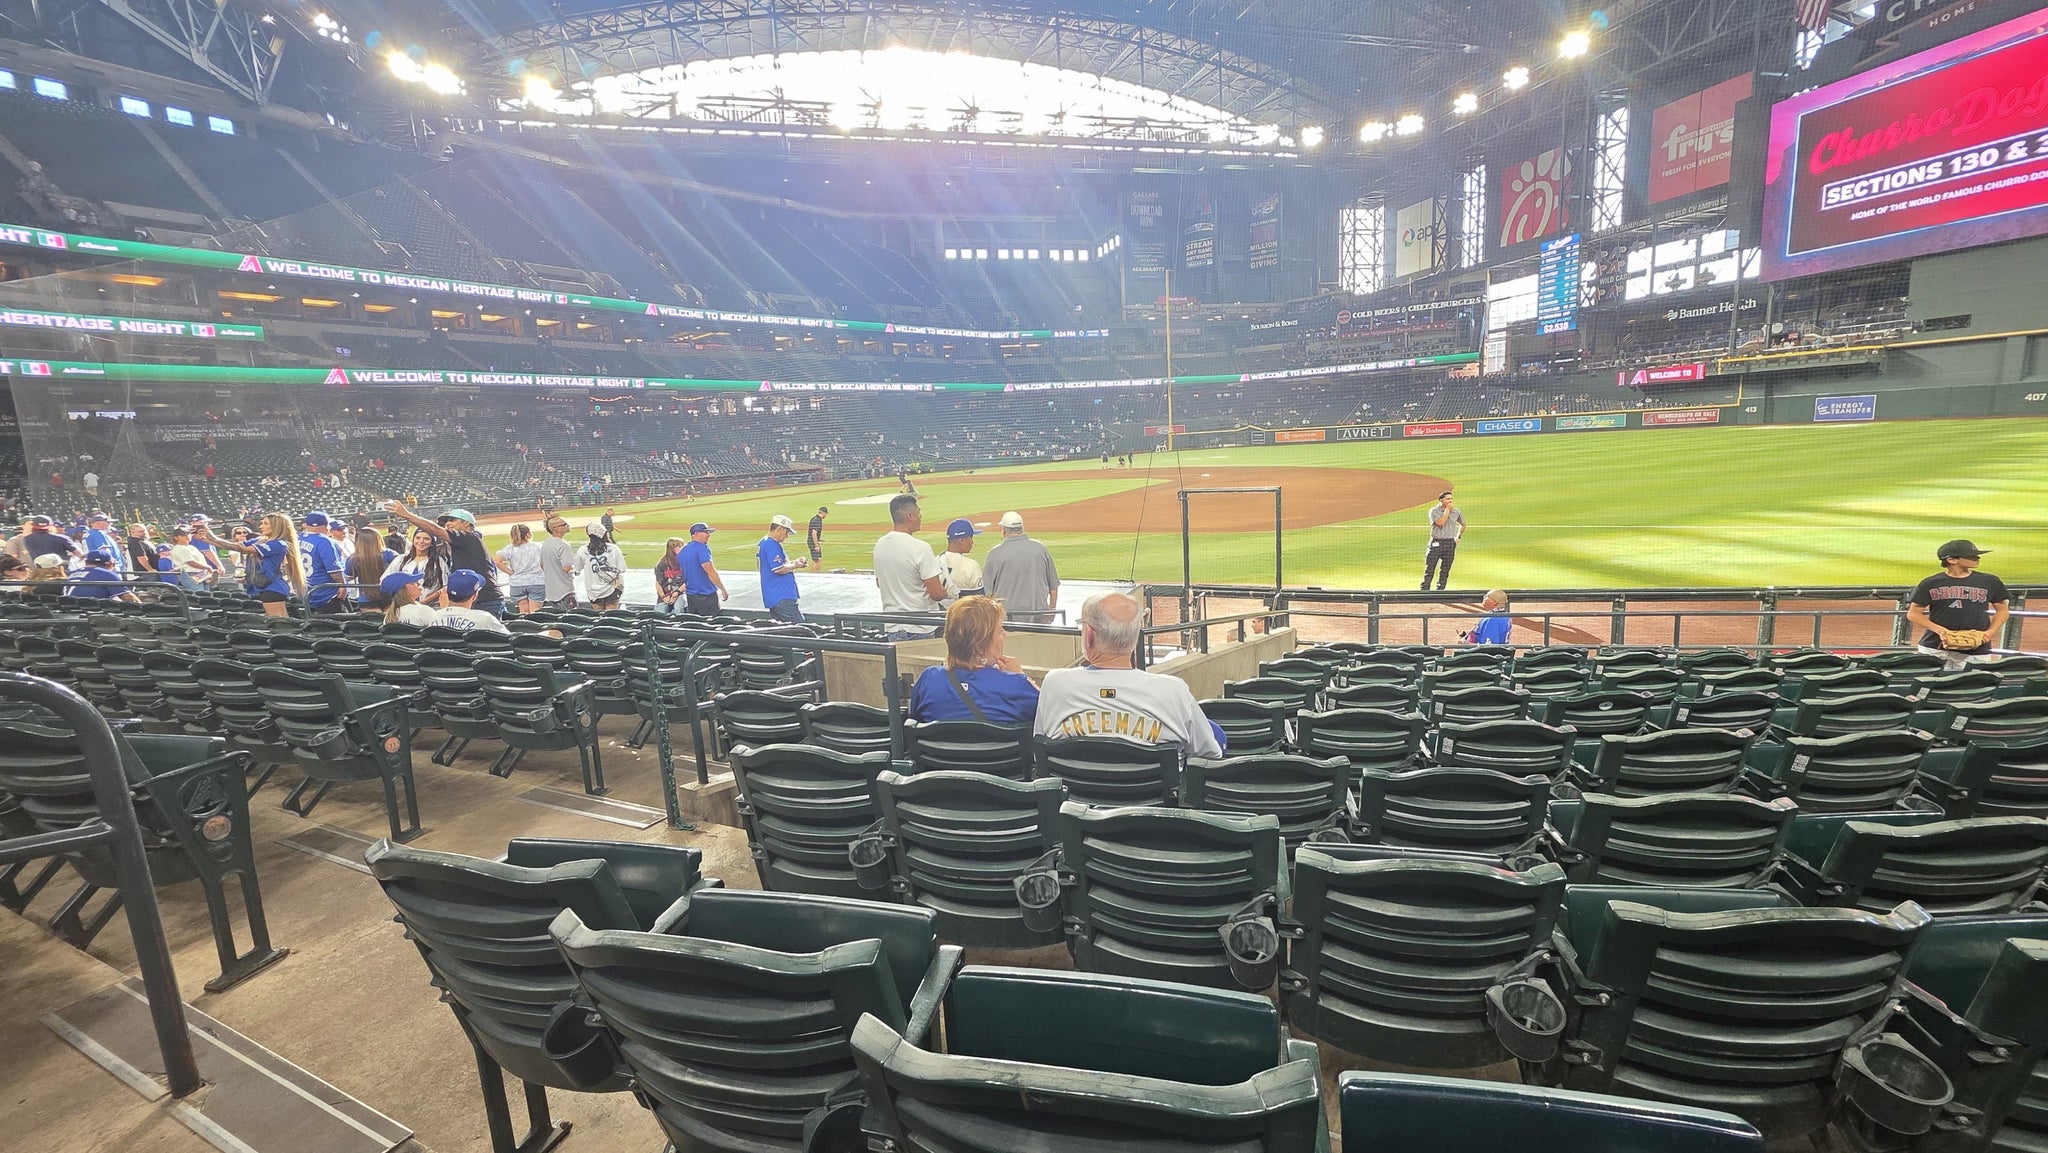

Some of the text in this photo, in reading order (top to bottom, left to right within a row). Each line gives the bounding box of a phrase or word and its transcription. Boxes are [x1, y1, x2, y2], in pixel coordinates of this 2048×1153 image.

[1929, 2, 1975, 28] HOME
[1661, 124, 1734, 162] fry's
[1808, 106, 1955, 175] Churro
[1661, 166, 1682, 178] FRESH
[1682, 162, 1697, 172] FOR
[1826, 161, 1942, 205] SECTIONS
[1949, 147, 1999, 174] 130
[2006, 140, 2028, 161] &
[1851, 207, 1876, 221] HOME
[1876, 204, 1888, 214] OF
[1889, 201, 1907, 212] THE
[1908, 193, 1941, 209] WORLD
[1941, 183, 1983, 201] FAMOUS
[1984, 174, 2028, 191] CHURRO
[1130, 204, 1163, 216] DOWNLOAD
[1664, 207, 1687, 220] WORLD
[1186, 240, 1213, 251] STREAM
[1249, 240, 1278, 251] MILLION
[1250, 258, 1278, 269] GIVING
[266, 260, 355, 282] WELCOME
[359, 271, 381, 284] TO
[384, 274, 450, 292] MEXICAN
[452, 282, 516, 299] HERITAGE
[517, 290, 553, 303] NIGHT
[1352, 310, 1373, 319] COLD
[1374, 306, 1400, 316] BEERS
[1408, 296, 1481, 312] CHEESEBURGERS
[1678, 305, 1718, 320] Banner
[0, 312, 185, 335] HERITAGE NIGHT
[659, 306, 704, 319] WELCOME
[705, 310, 718, 320] TO
[720, 311, 759, 323] MEXICAN
[760, 315, 799, 325] HERITAGE
[799, 318, 823, 327] NIGHT
[894, 325, 927, 334] WELCOME
[928, 327, 936, 335] TO
[936, 327, 962, 337] MEXICAN
[1251, 369, 1288, 380] WELCOME
[1288, 368, 1300, 377] TO
[1301, 365, 1337, 376] MEXICAN
[1337, 361, 1377, 373] HERITAGE
[1378, 358, 1404, 370] NIGHT
[1650, 370, 1684, 380] WELCOME
[1684, 369, 1692, 377] TO
[352, 370, 443, 383] WELCOME
[446, 373, 468, 384] TO
[471, 373, 532, 386] MEXICAN
[535, 375, 595, 387] HERITAGE
[597, 377, 629, 388] NIGHT
[1014, 382, 1051, 391] WELCOME
[1052, 381, 1063, 389] TO
[1064, 380, 1097, 389] MEXICAN
[1097, 379, 1131, 388] HERITAGE
[1131, 378, 1152, 387] NIGHT
[773, 382, 812, 391] WELCOME
[813, 382, 828, 391] TO
[830, 382, 865, 391] MEXICAN
[866, 383, 901, 391] HERITAGE
[902, 383, 923, 391] NIGHT
[2024, 393, 2047, 401] 407
[1831, 407, 1872, 415] TRANSFER
[1343, 427, 1385, 438] AVNET
[1425, 426, 1457, 434] Budweiser
[1484, 421, 1521, 431] CHASE
[1061, 711, 1163, 744] FREEMAN
